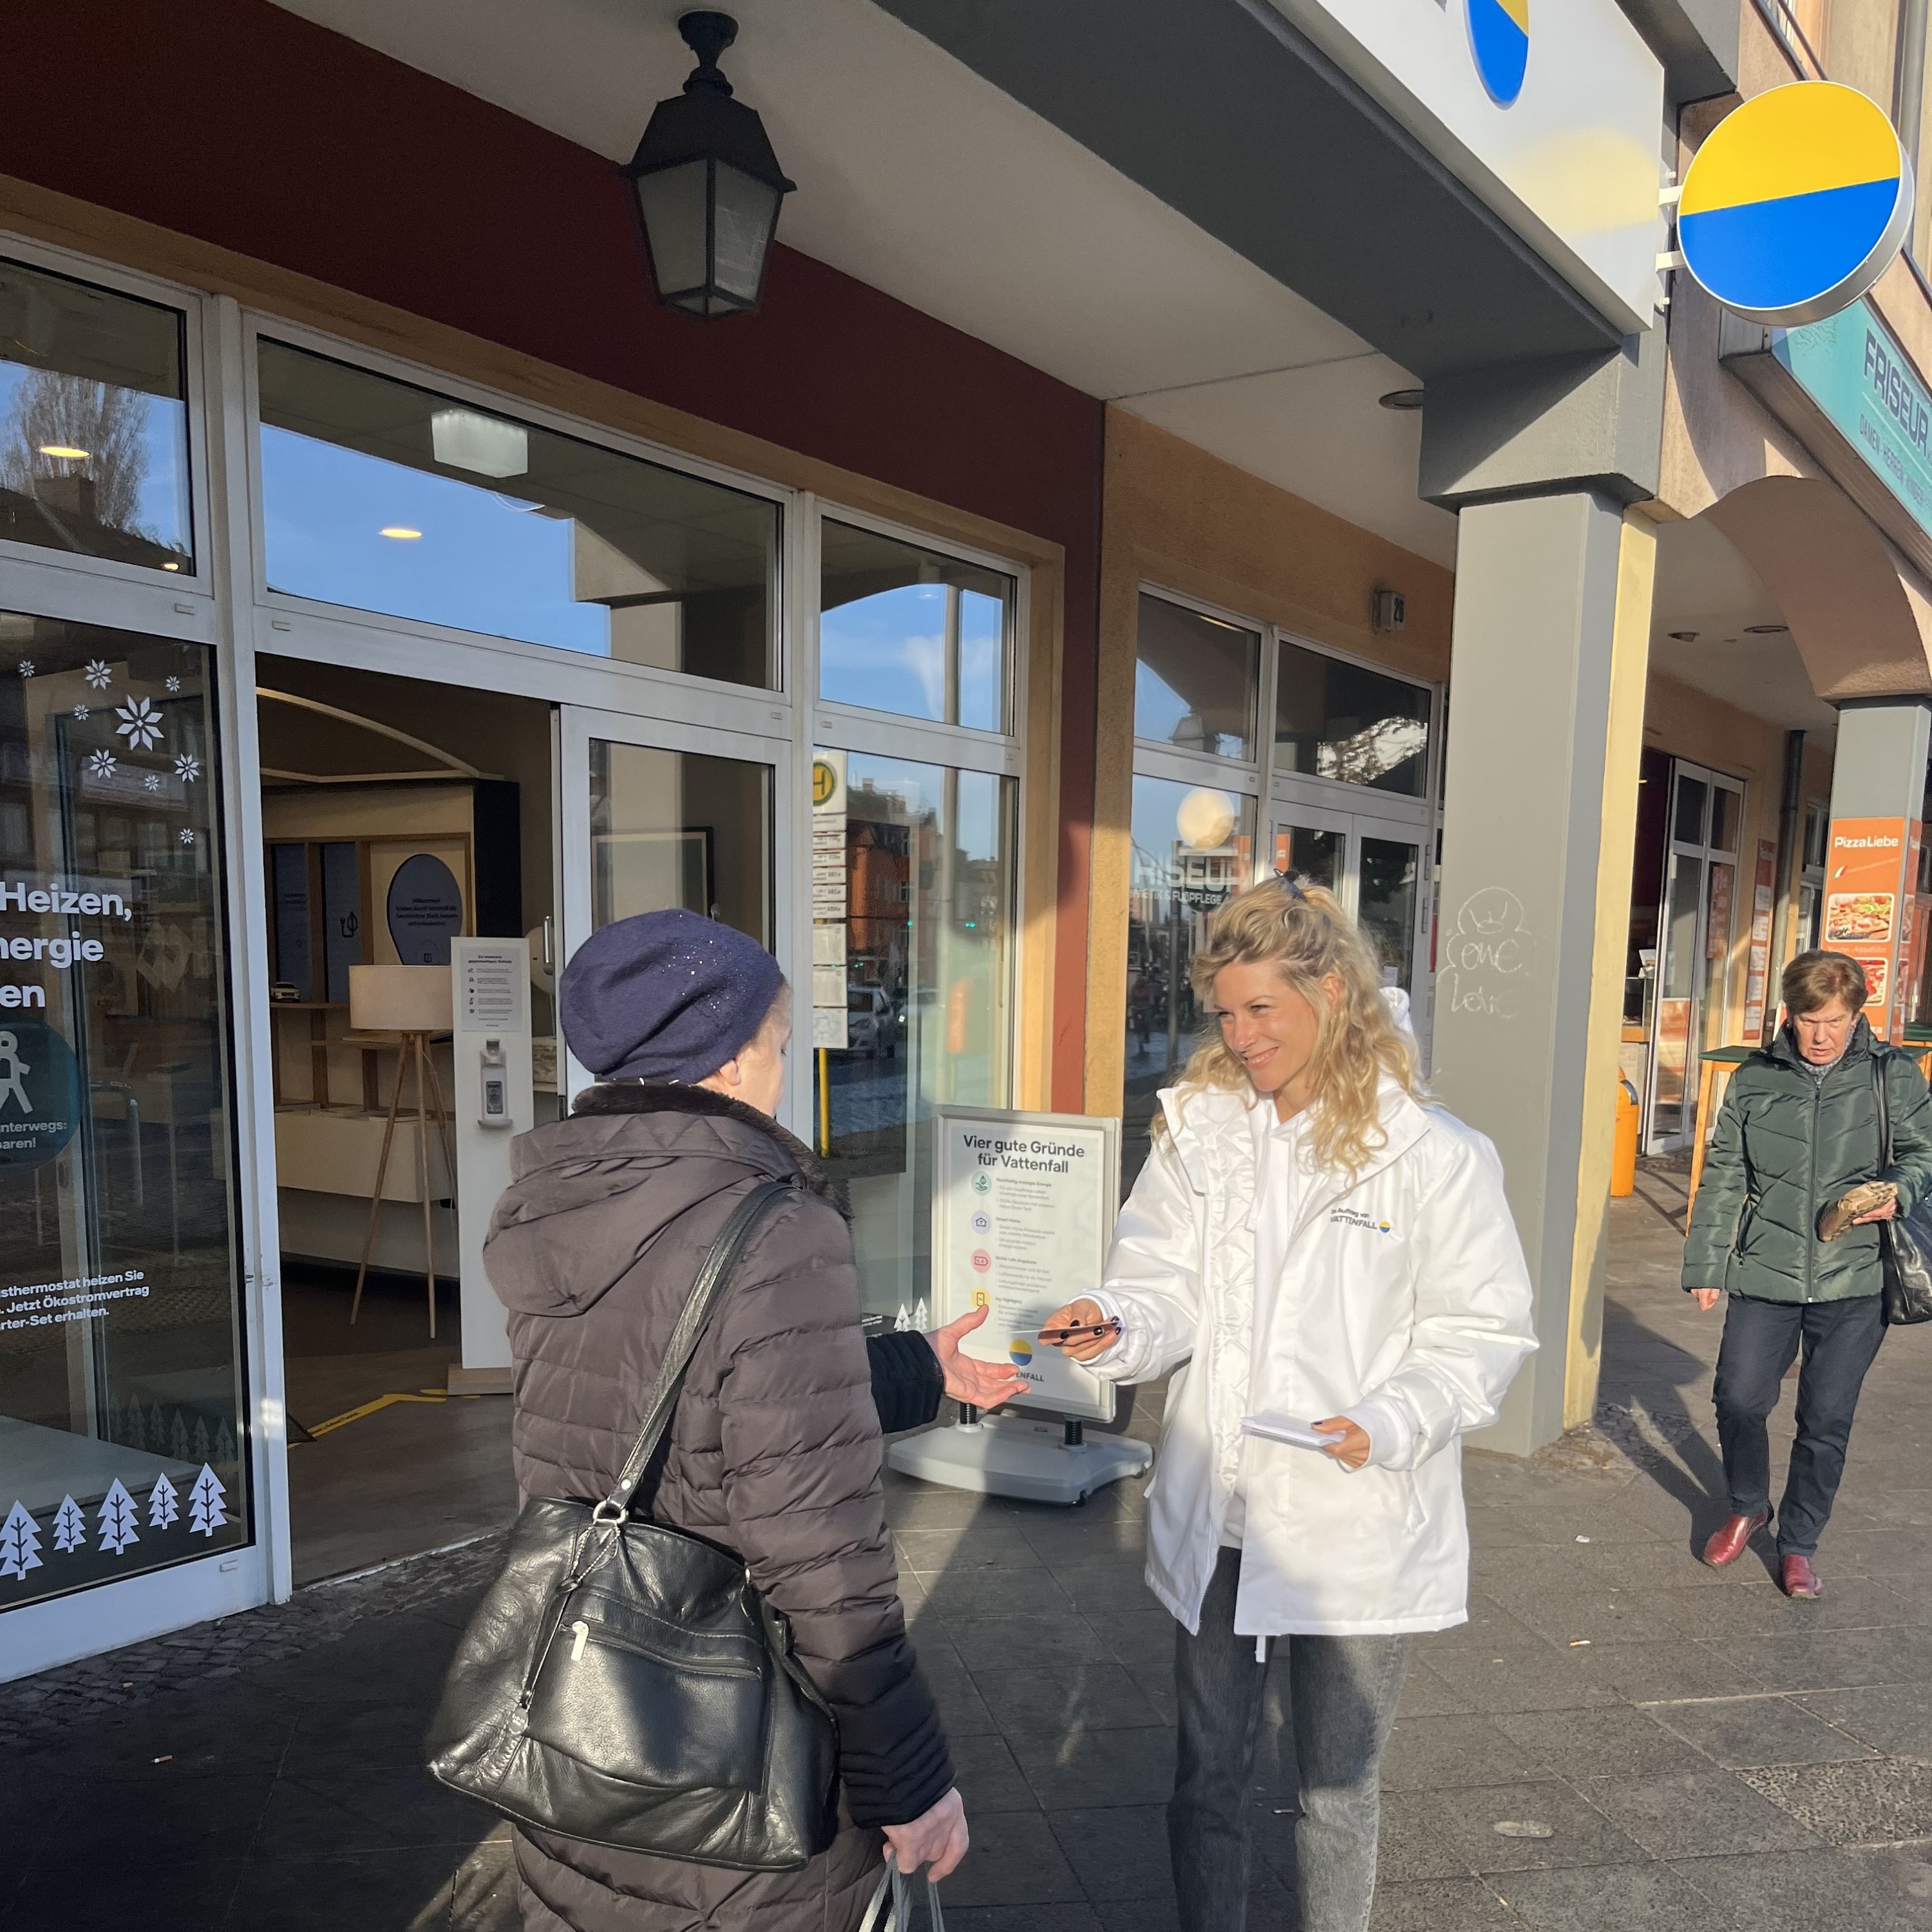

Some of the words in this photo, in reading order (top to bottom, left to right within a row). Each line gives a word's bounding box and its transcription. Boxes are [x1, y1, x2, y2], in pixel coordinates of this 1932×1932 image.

[1864, 328, 1928, 458] FRISEUR
[0, 882, 131, 922] Heizen,
[0, 1137, 36, 1150] aren!
[963, 1135, 992, 1149] Vier
[995, 1139, 1027, 1153] gute
[1030, 1141, 1085, 1158] Gründe
[978, 1153, 998, 1166] für
[1000, 1155, 1069, 1173] Vattenfall
[0, 1278, 80, 1298] sthermostat
[83, 1271, 123, 1287] heizen
[125, 1269, 144, 1282] Sie
[6, 1300, 41, 1313] Jetzt
[43, 1286, 149, 1308] Ökostromvertrag
[0, 1314, 52, 1331] rter-Set
[55, 1308, 109, 1322] erhalten.
